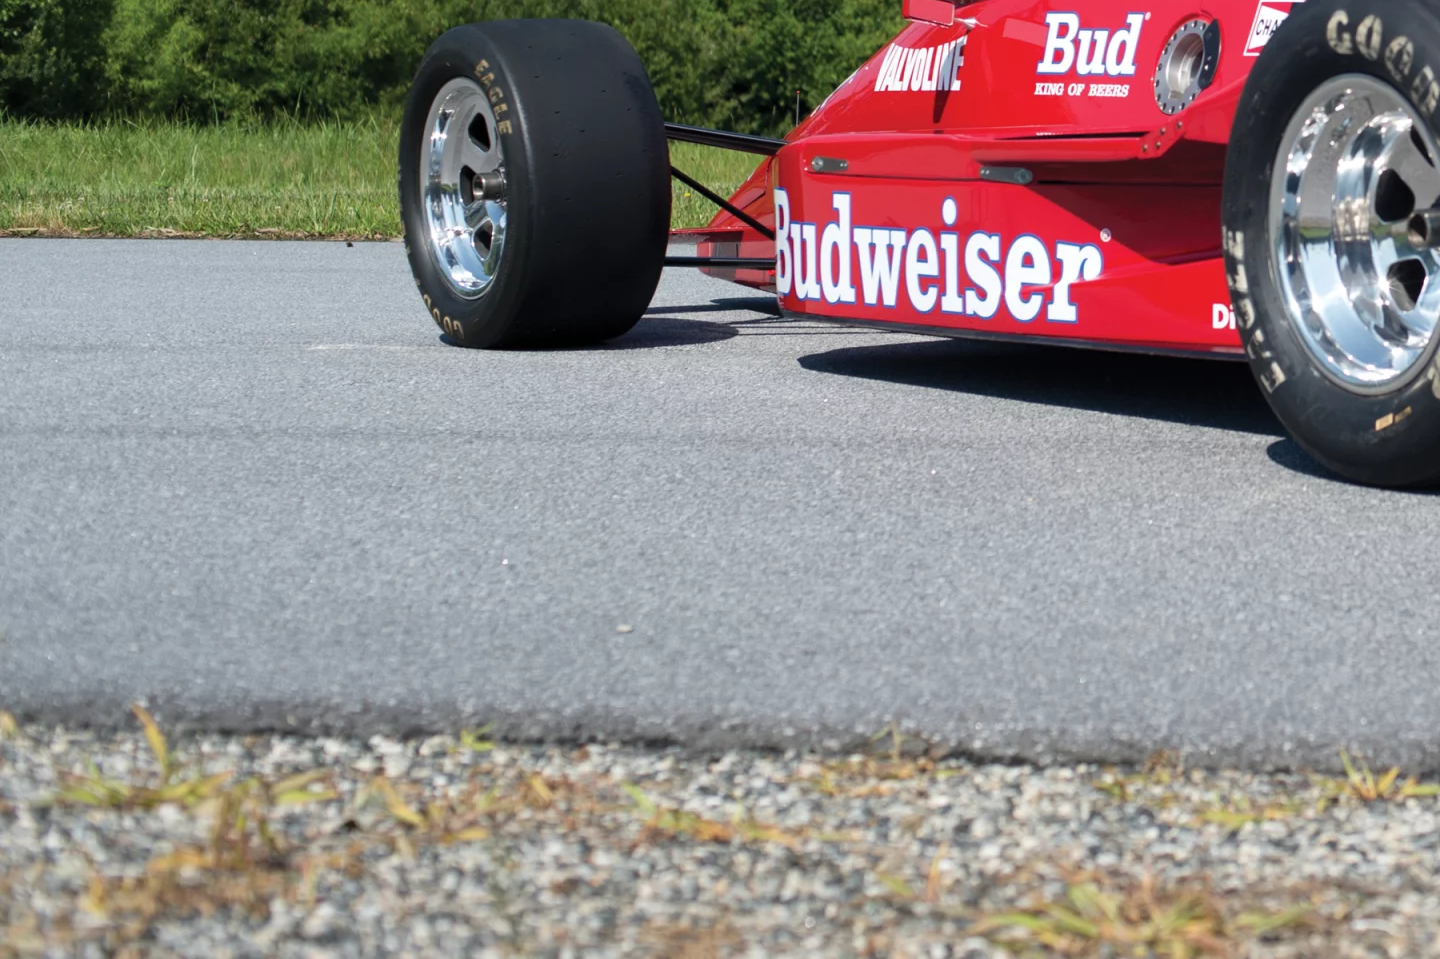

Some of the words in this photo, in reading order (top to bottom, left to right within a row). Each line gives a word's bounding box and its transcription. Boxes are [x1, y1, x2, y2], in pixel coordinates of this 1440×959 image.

[874, 35, 968, 92] VALVOLINE
[1036, 11, 1145, 78] Bud
[473, 58, 513, 136] EAGLE
[1034, 83, 1064, 96] KING
[1067, 83, 1085, 96] OF
[1088, 83, 1130, 98] BEERS
[773, 187, 1104, 323] Budweiser
